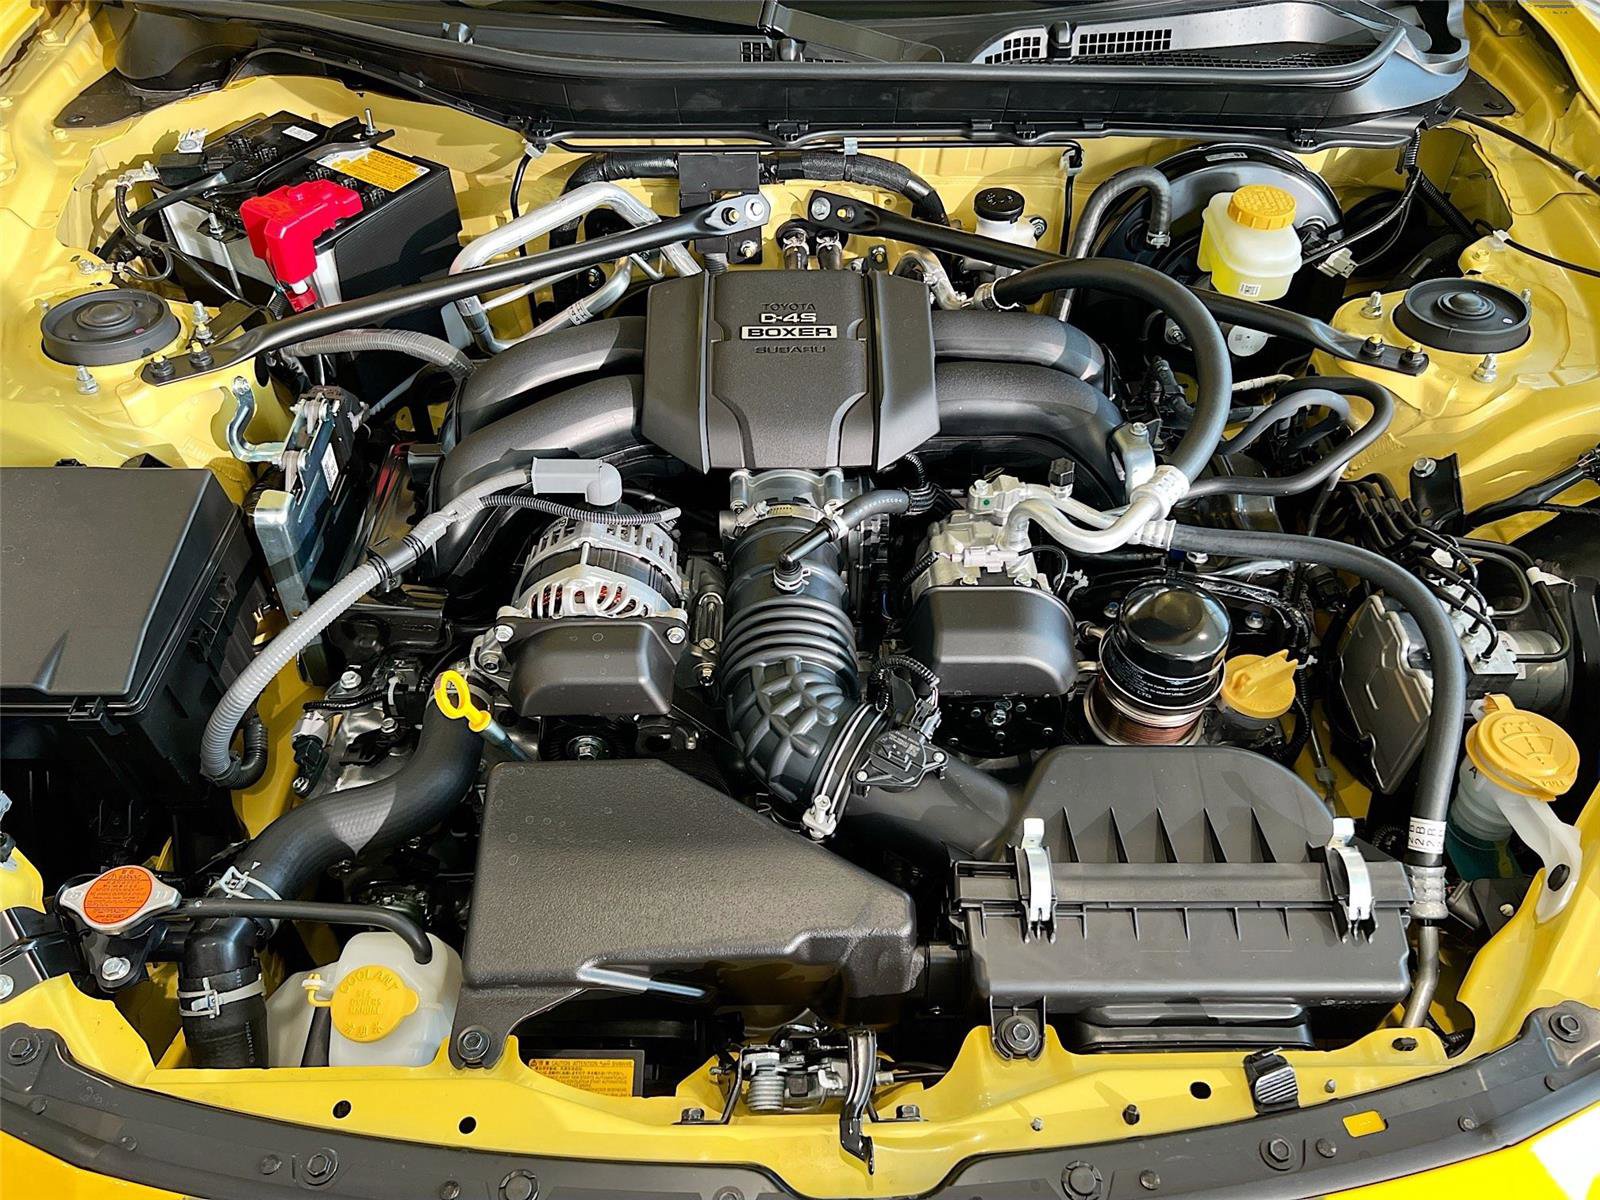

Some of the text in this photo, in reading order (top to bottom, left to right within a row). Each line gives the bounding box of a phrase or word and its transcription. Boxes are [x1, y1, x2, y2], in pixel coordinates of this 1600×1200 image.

[762, 302, 817, 311] TOYOTA
[760, 312, 817, 323] D-4S
[747, 327, 832, 337] BOXER
[755, 345, 826, 354] SUBARU
[340, 969, 399, 993] COOLANT
